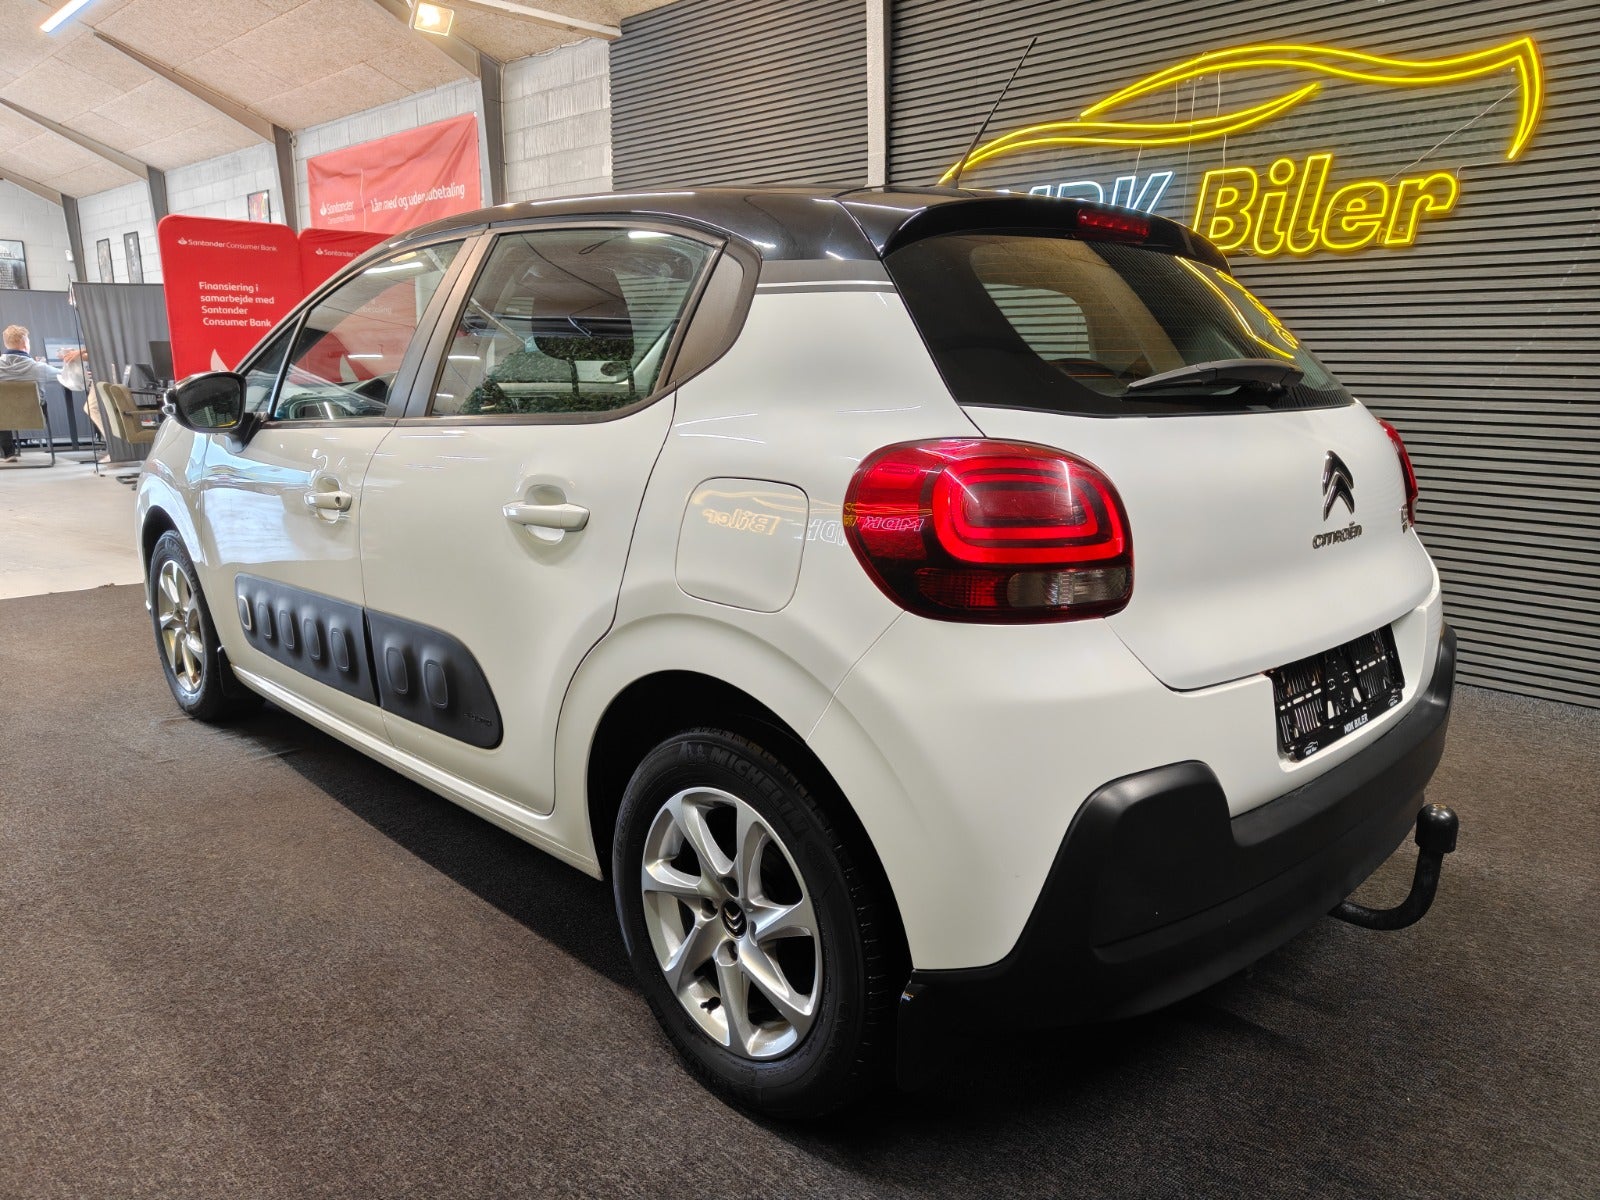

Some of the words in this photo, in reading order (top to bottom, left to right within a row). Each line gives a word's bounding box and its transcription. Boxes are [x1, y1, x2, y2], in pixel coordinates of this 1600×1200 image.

[398, 197, 408, 210] og
[1191, 152, 1458, 256] Biler
[188, 239, 225, 248] Santander
[225, 242, 260, 251] Consumer
[260, 244, 278, 252] Bank
[323, 249, 354, 258] Santander
[199, 281, 254, 293] Finansiering
[200, 294, 254, 305] samarbejde
[255, 296, 275, 304] med
[201, 305, 248, 315] Santander
[202, 317, 248, 327] Consumer
[249, 318, 272, 328] Bank
